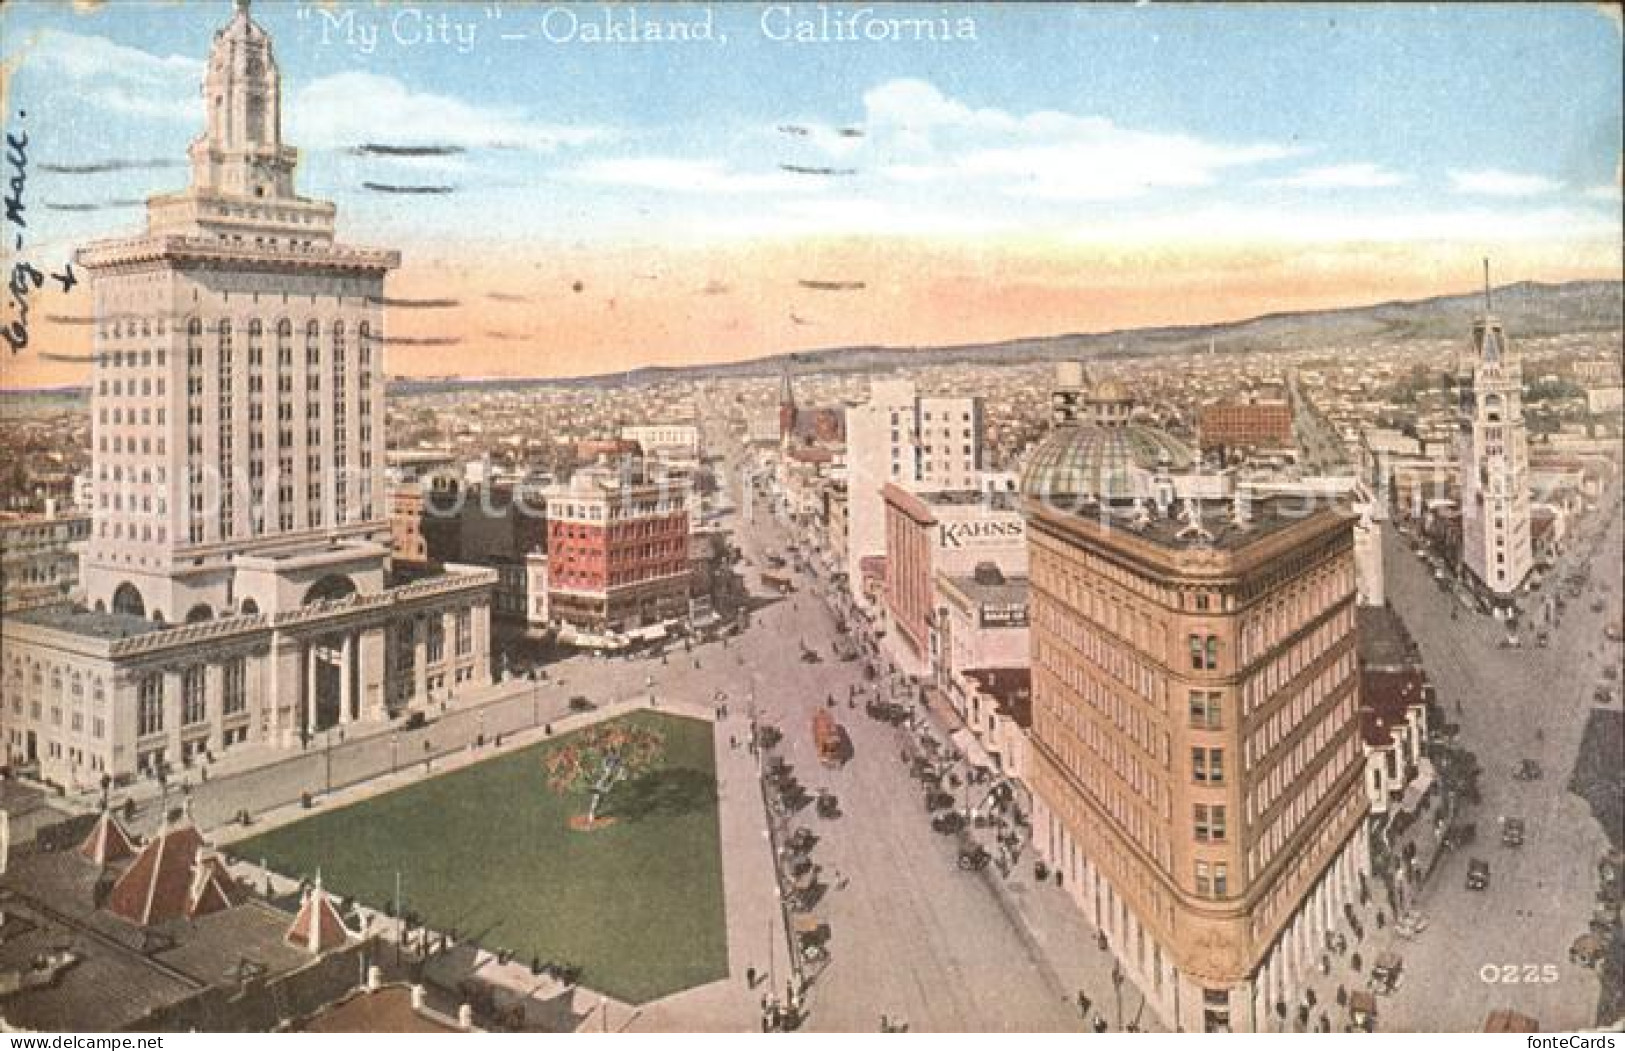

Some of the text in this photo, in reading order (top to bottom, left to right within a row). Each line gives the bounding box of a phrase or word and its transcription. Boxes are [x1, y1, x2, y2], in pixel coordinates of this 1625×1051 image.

[541, 6, 728, 45] Oakland,
[760, 5, 979, 42] California
[1480, 963, 1559, 983] 0225
